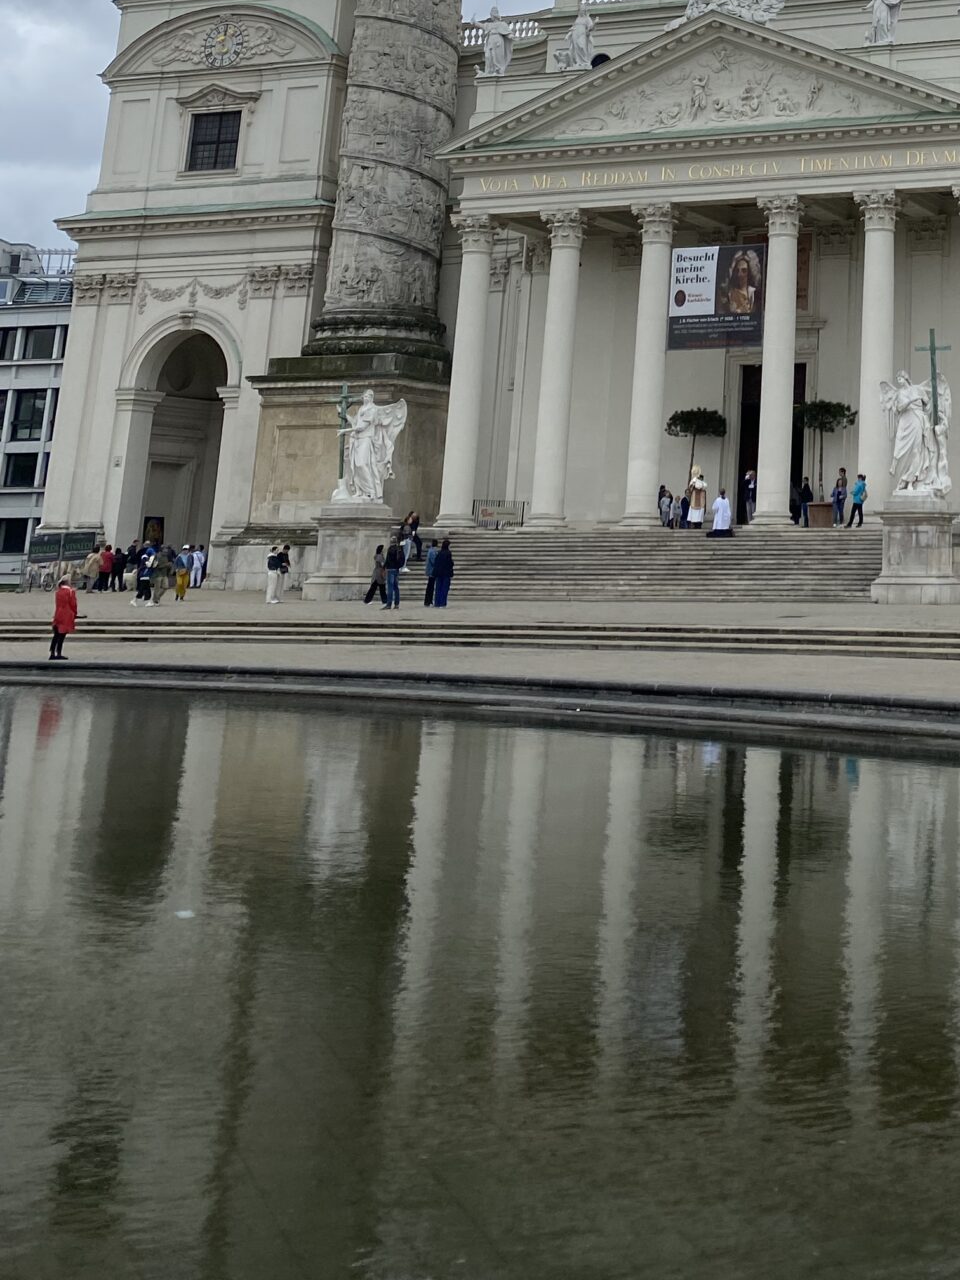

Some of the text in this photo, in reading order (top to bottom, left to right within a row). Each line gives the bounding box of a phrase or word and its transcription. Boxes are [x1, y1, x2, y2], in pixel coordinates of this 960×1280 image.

[531, 174, 568, 190] MEA
[580, 170, 649, 187] REDDAM
[676, 252, 715, 263] Besucht
[675, 263, 705, 274] meine
